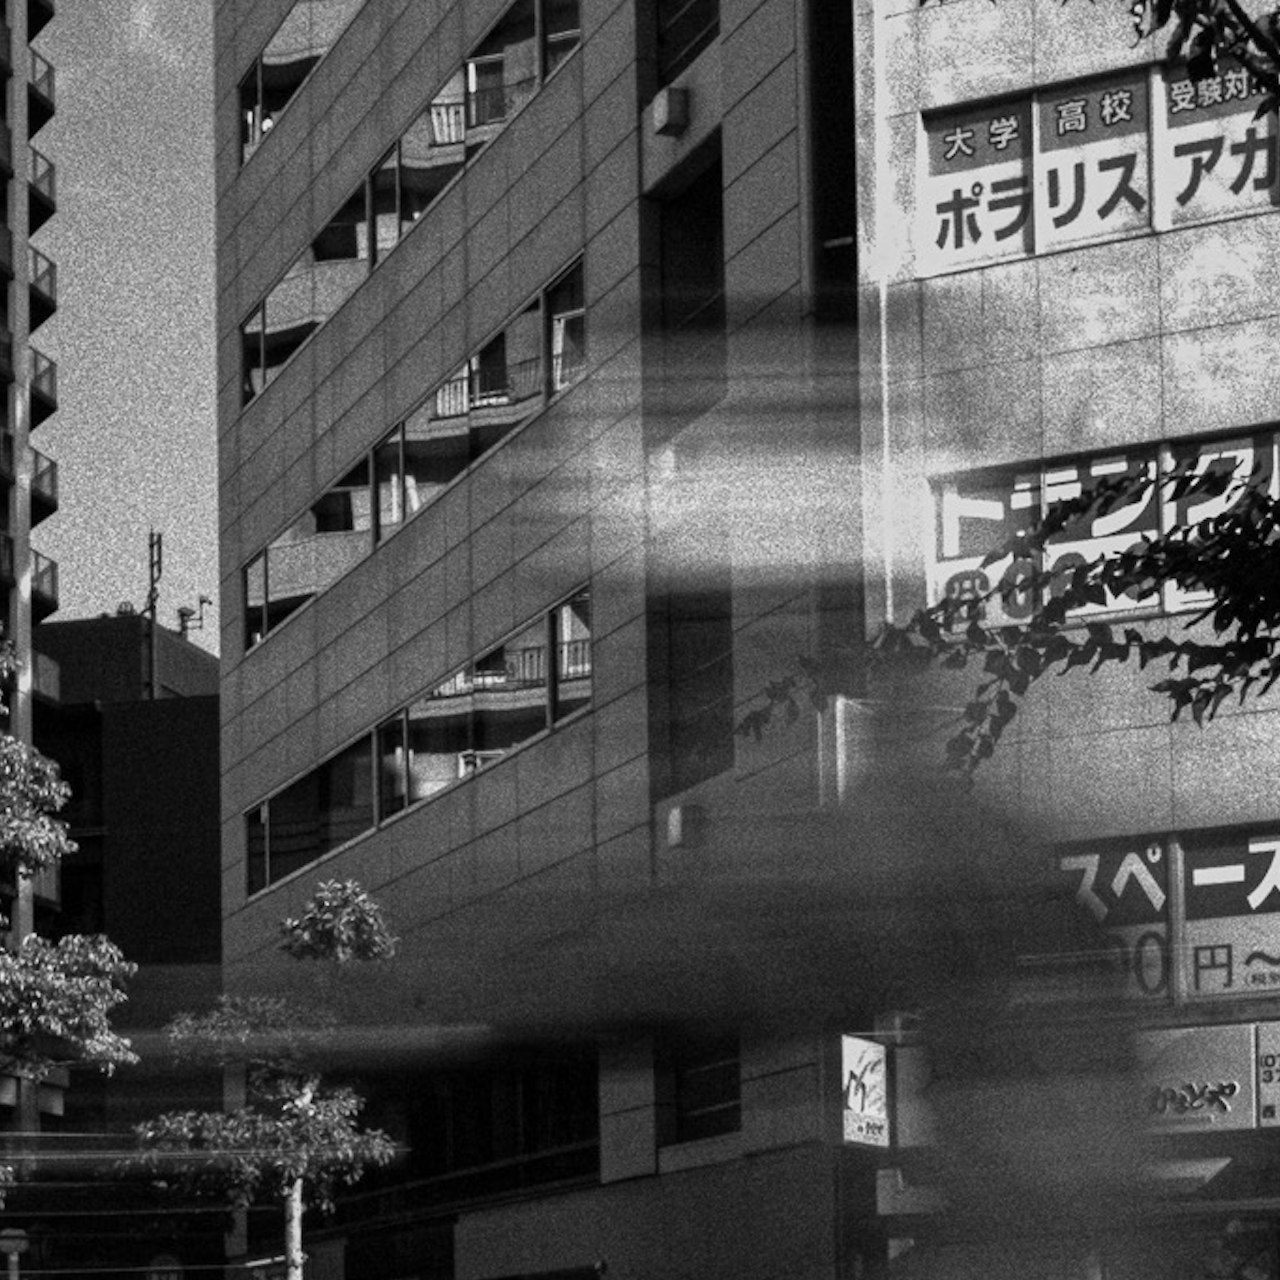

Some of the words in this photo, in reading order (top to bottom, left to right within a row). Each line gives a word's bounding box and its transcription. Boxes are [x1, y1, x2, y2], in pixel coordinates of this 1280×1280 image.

[943, 116, 1020, 160] 大学
[1055, 90, 1133, 137] 高校
[1170, 67, 1268, 114] 受験対
[935, 152, 1147, 249] ポラリス
